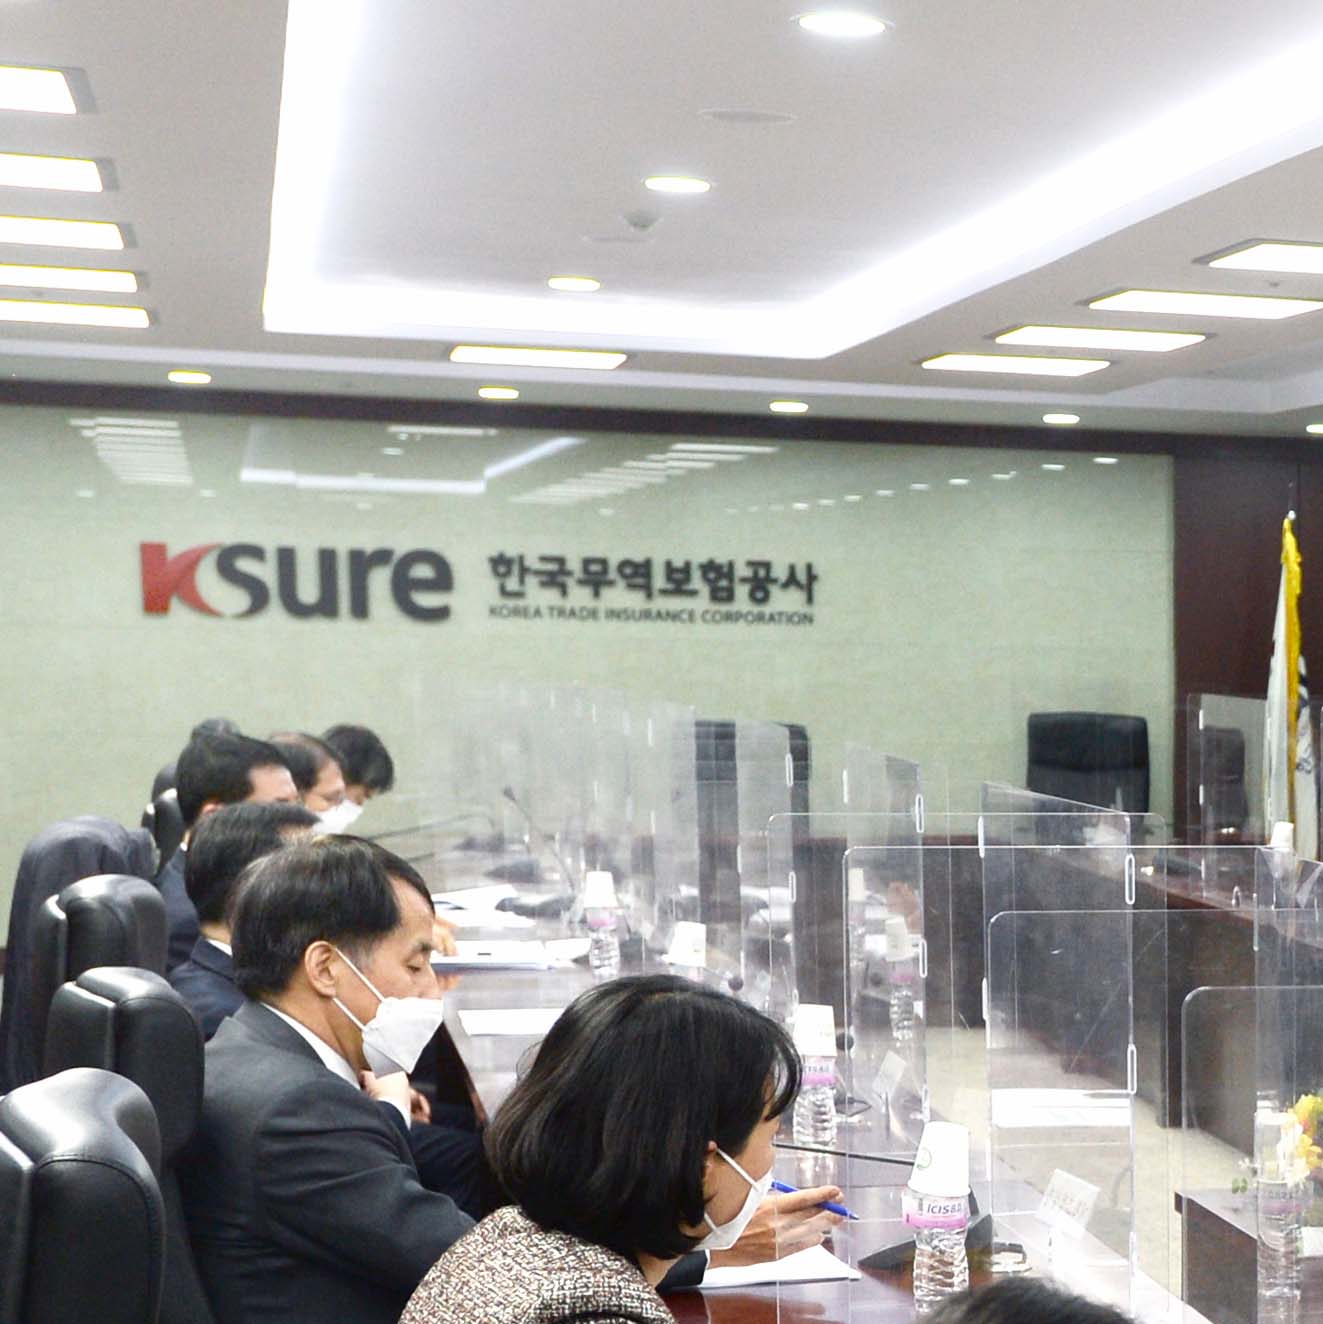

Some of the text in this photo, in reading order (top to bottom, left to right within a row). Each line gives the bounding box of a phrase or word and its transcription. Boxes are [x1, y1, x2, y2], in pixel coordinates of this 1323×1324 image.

[488, 550, 819, 605] 한국무역보험공사
[488, 605, 814, 625] KOREA TRADE INSURANCE CORPORATION
